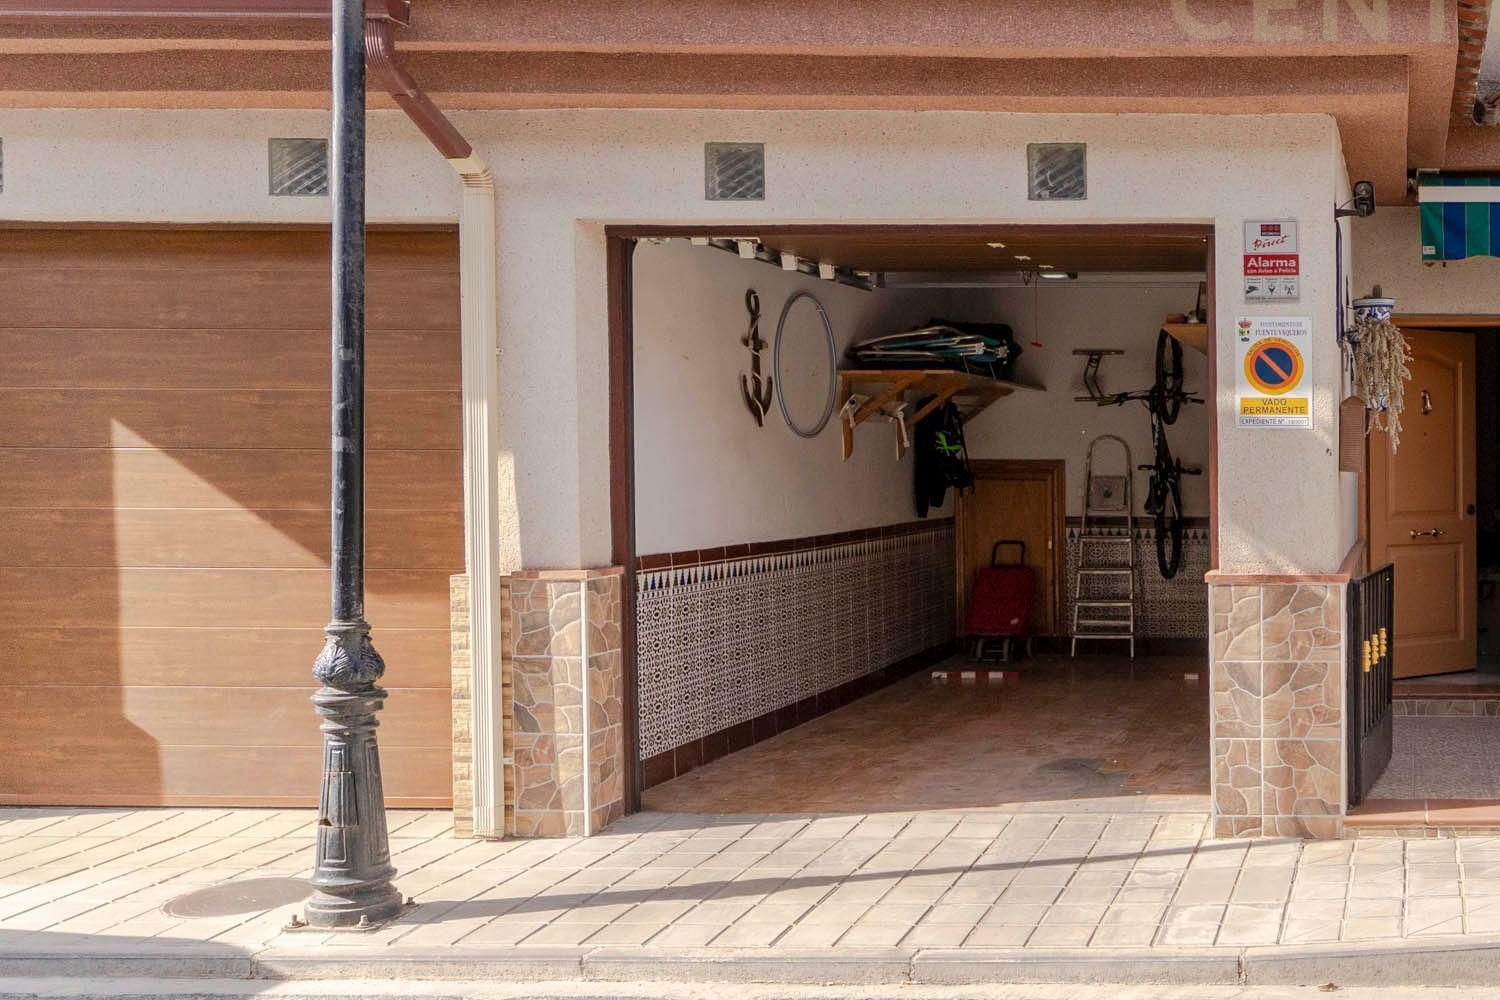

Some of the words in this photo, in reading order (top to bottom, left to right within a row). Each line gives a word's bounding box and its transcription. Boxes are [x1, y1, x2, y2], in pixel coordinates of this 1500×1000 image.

[1247, 257, 1296, 267] Alarma
[1263, 398, 1287, 406] VADO
[1243, 406, 1305, 414] PERMANENTE
